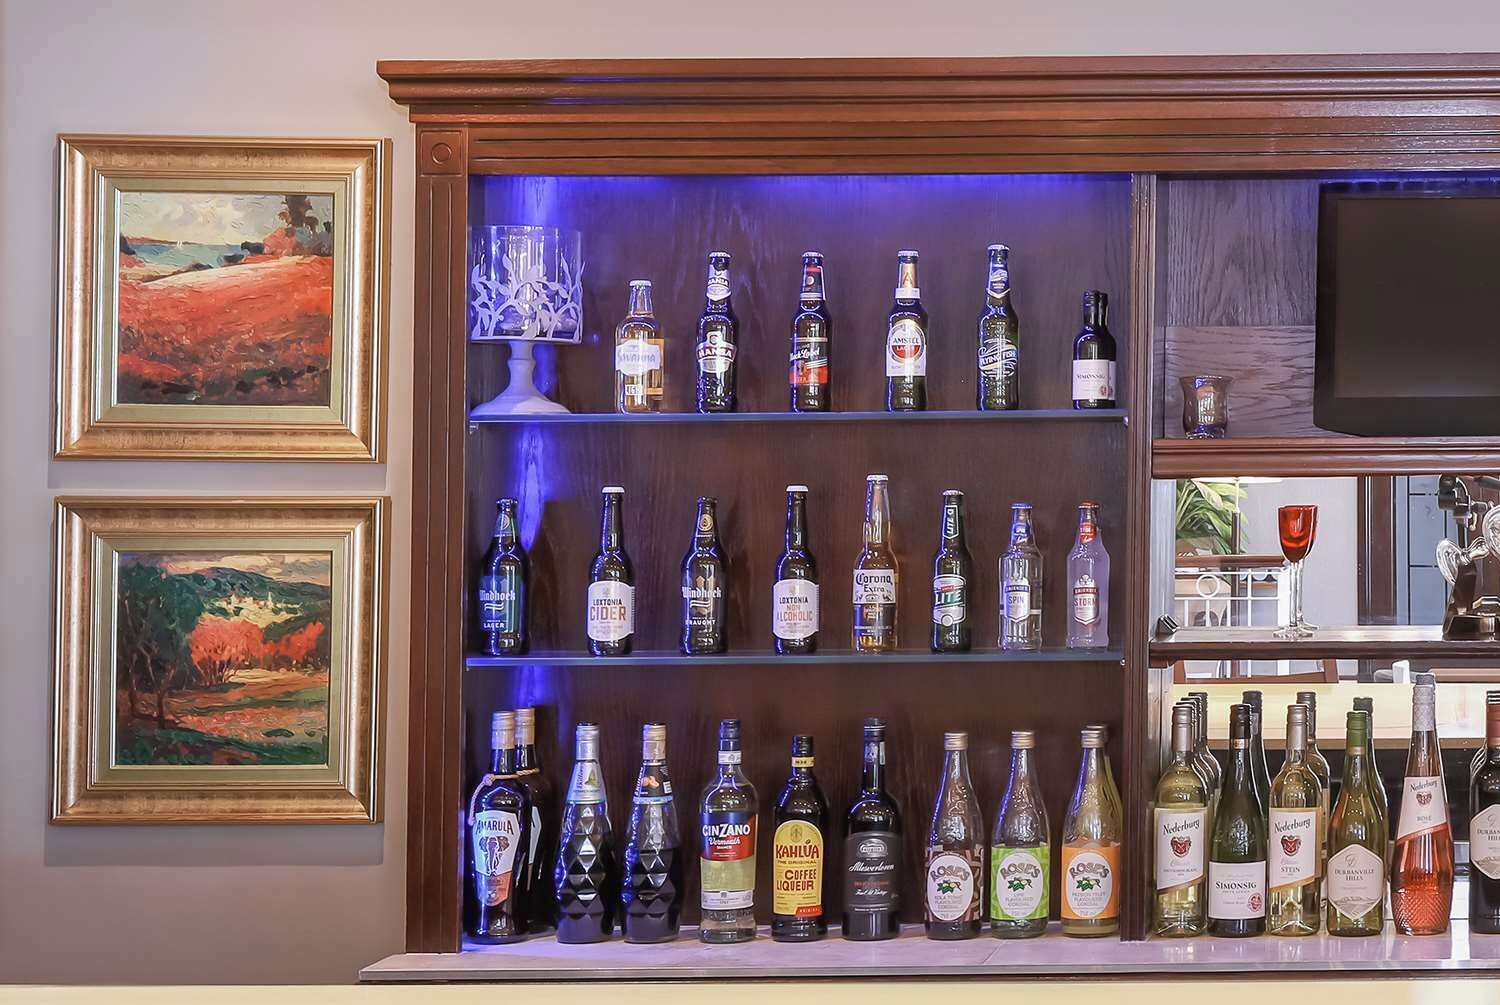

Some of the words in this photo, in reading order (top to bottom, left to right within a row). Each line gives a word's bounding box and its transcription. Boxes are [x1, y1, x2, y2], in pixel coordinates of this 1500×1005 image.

[893, 337, 921, 345] AMSTEL
[698, 349, 733, 359] HANSA
[979, 354, 1000, 367] FLYING
[1002, 350, 1017, 360] FISH
[855, 573, 893, 586] Corona
[479, 590, 516, 601] Windhoek
[681, 586, 722, 599] Windhoek
[863, 585, 886, 593] Extra
[934, 591, 962, 605] LITE
[1008, 596, 1025, 605] SPIN
[589, 606, 627, 621] CIDER
[1410, 780, 1439, 793] Nederburg
[475, 819, 514, 835] AMARULA
[702, 823, 751, 838] CINZANO
[1163, 818, 1201, 836] Nederburg
[1274, 817, 1312, 834] Nederburg
[784, 868, 817, 880] COFFEE
[930, 864, 970, 882] ROSE'S
[1000, 862, 1041, 880] ROSE'S
[1069, 862, 1110, 879] ROSE'S
[776, 879, 814, 892] LIQUEUR
[1215, 881, 1257, 890] SIMONSIG
